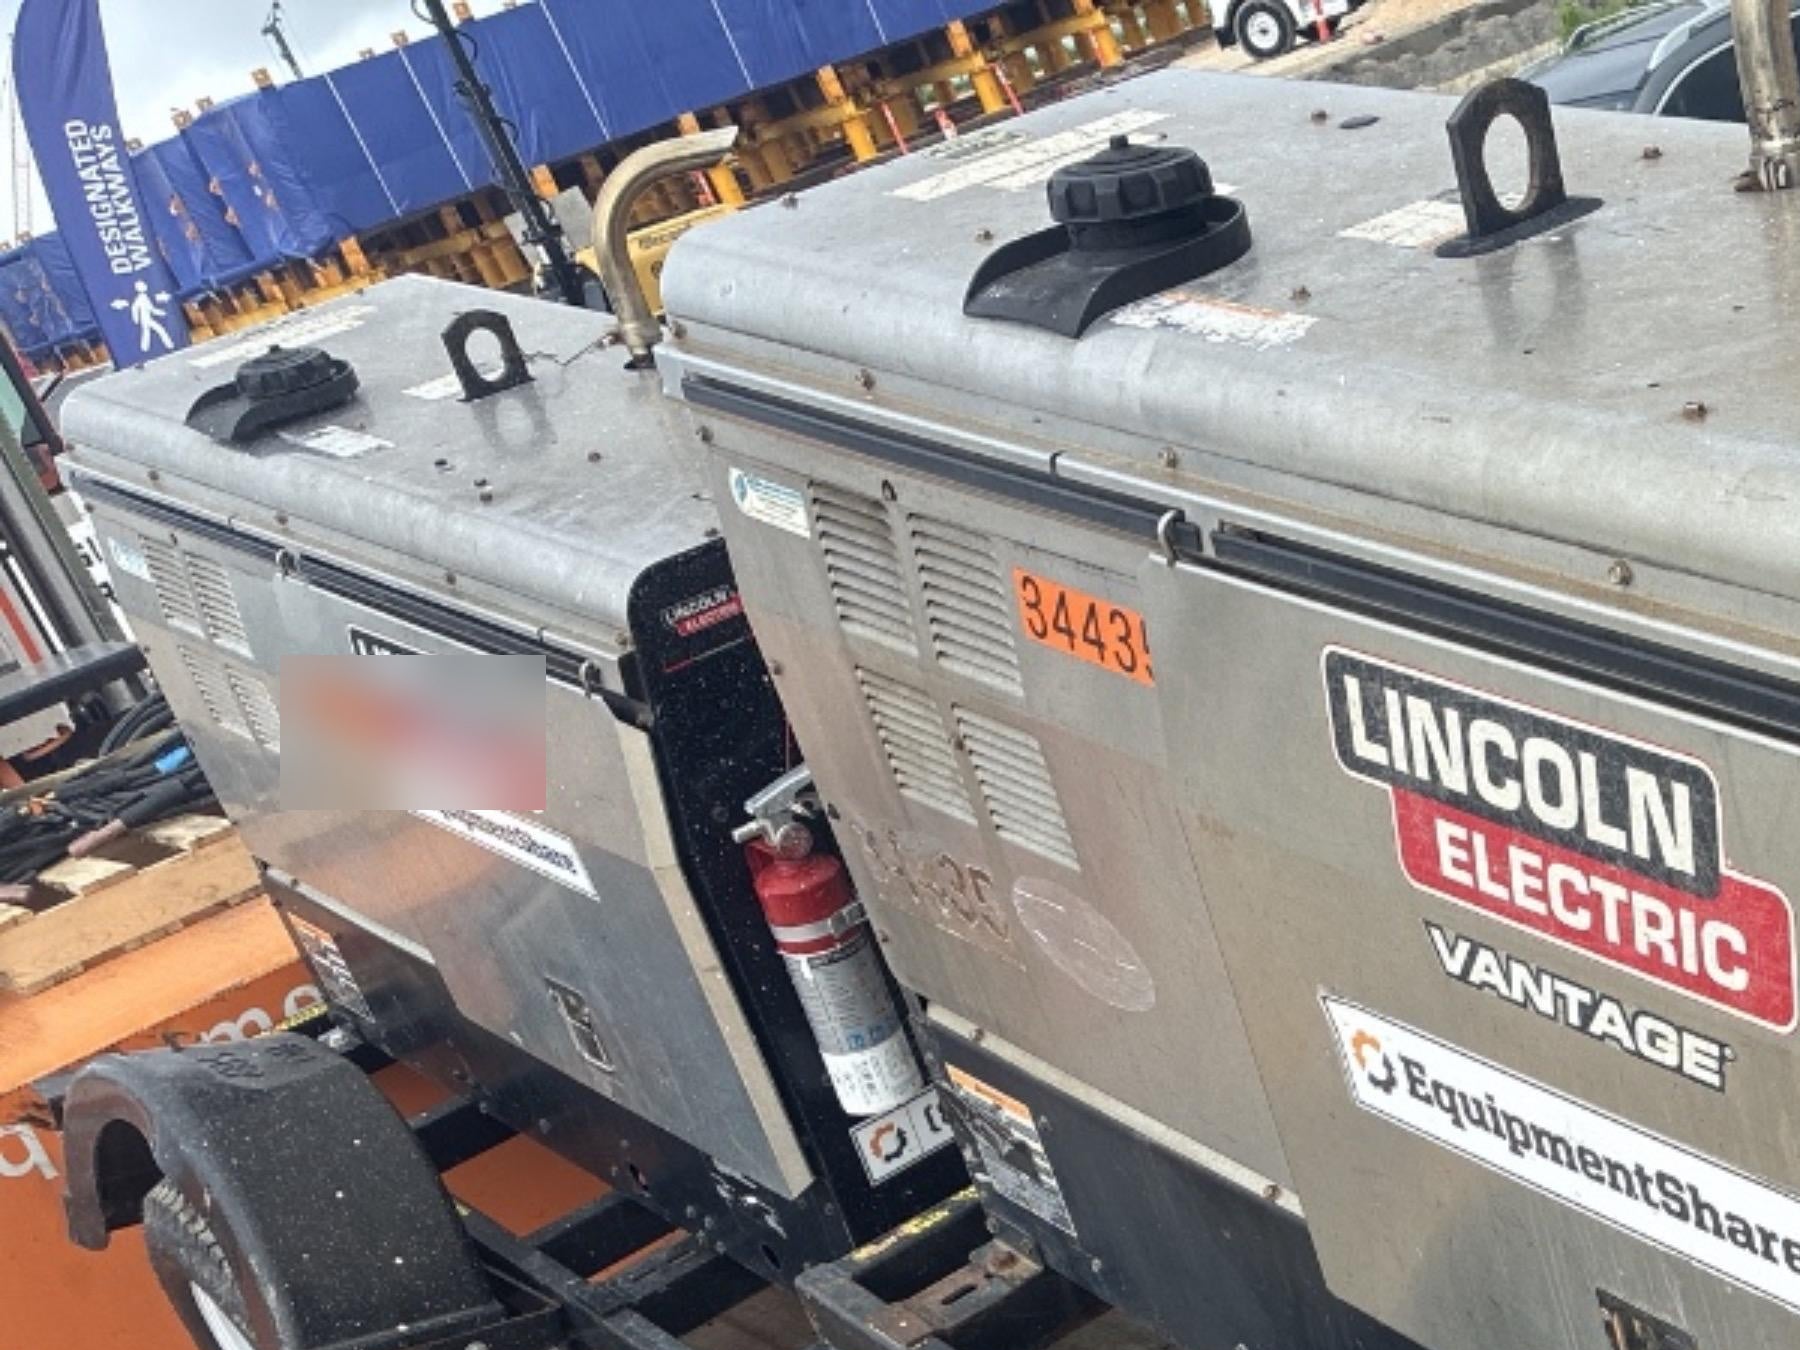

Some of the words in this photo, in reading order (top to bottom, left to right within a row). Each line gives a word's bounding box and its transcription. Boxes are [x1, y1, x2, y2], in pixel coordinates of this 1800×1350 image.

[65, 119, 134, 274] DESIGNATED
[90, 125, 152, 271] WALKWAYS
[1343, 675, 1696, 877] LINCOLN
[1434, 818, 1749, 992] ELECTRIC
[1425, 920, 1725, 1093] VANTAGE
